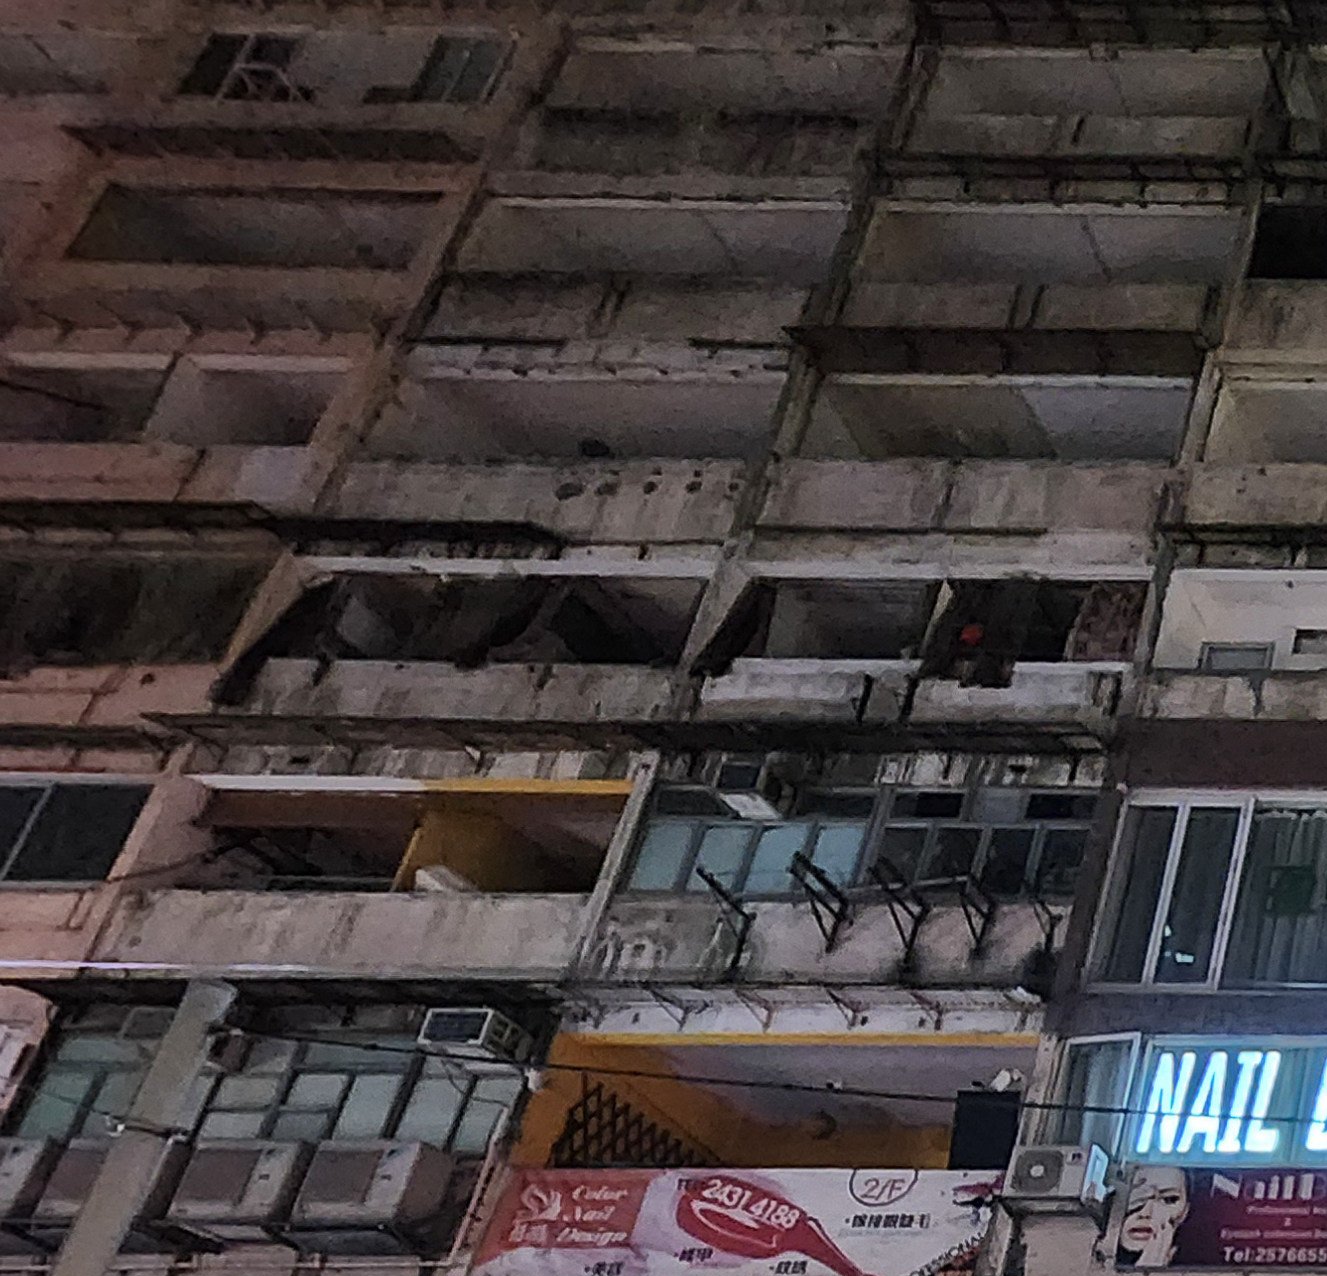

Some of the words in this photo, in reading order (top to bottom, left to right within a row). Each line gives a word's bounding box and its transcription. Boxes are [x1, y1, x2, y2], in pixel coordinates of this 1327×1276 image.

[1138, 1051, 1281, 1154] NAIL
[702, 1179, 752, 1211] 2431
[750, 1198, 800, 1229] 4188
[861, 1178, 905, 1198] 2/F
